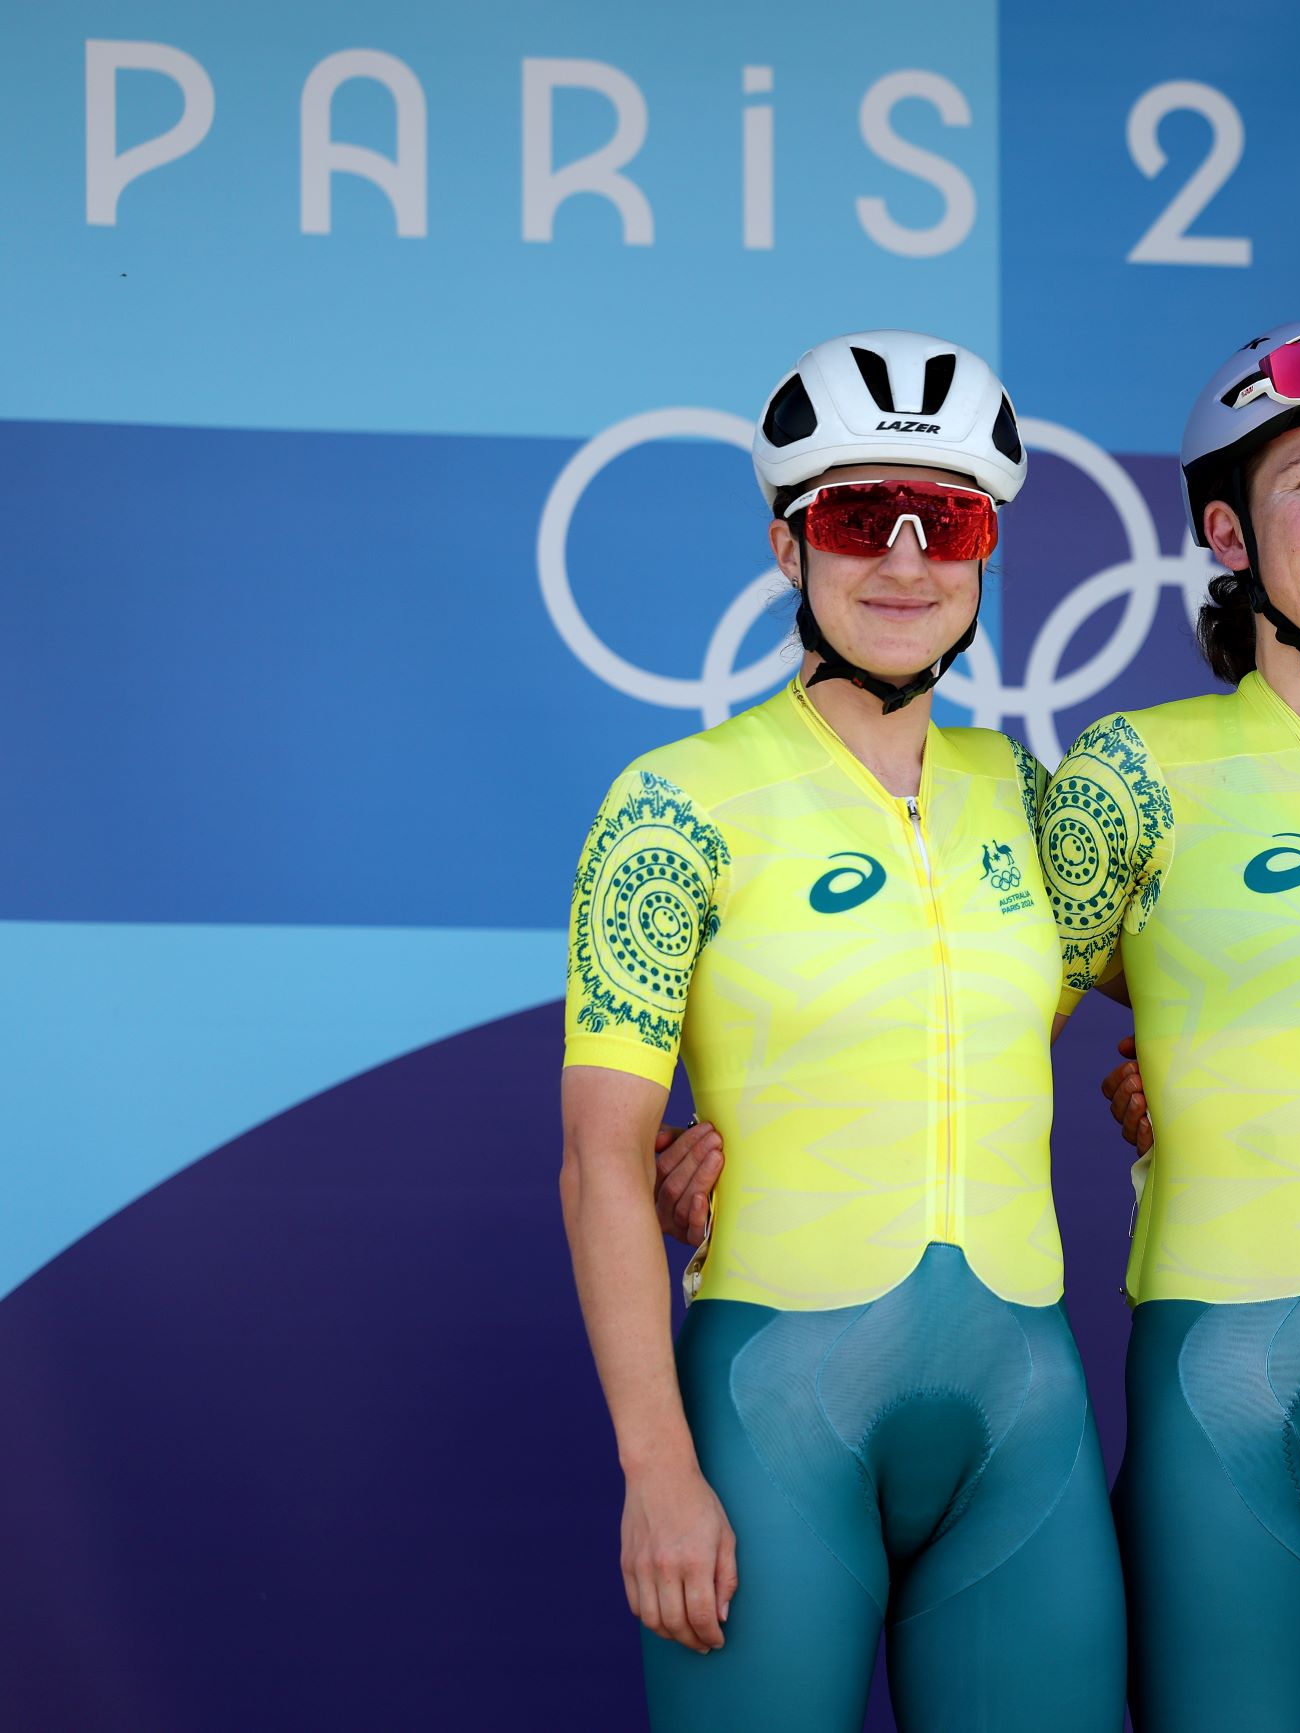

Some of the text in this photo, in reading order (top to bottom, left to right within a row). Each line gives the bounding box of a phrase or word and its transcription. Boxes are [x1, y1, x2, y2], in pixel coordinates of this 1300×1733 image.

[875, 420, 942, 435] LAZER
[1000, 890, 1031, 907] AUSTRALIA
[1002, 899, 1034, 915] PARIS 2024
